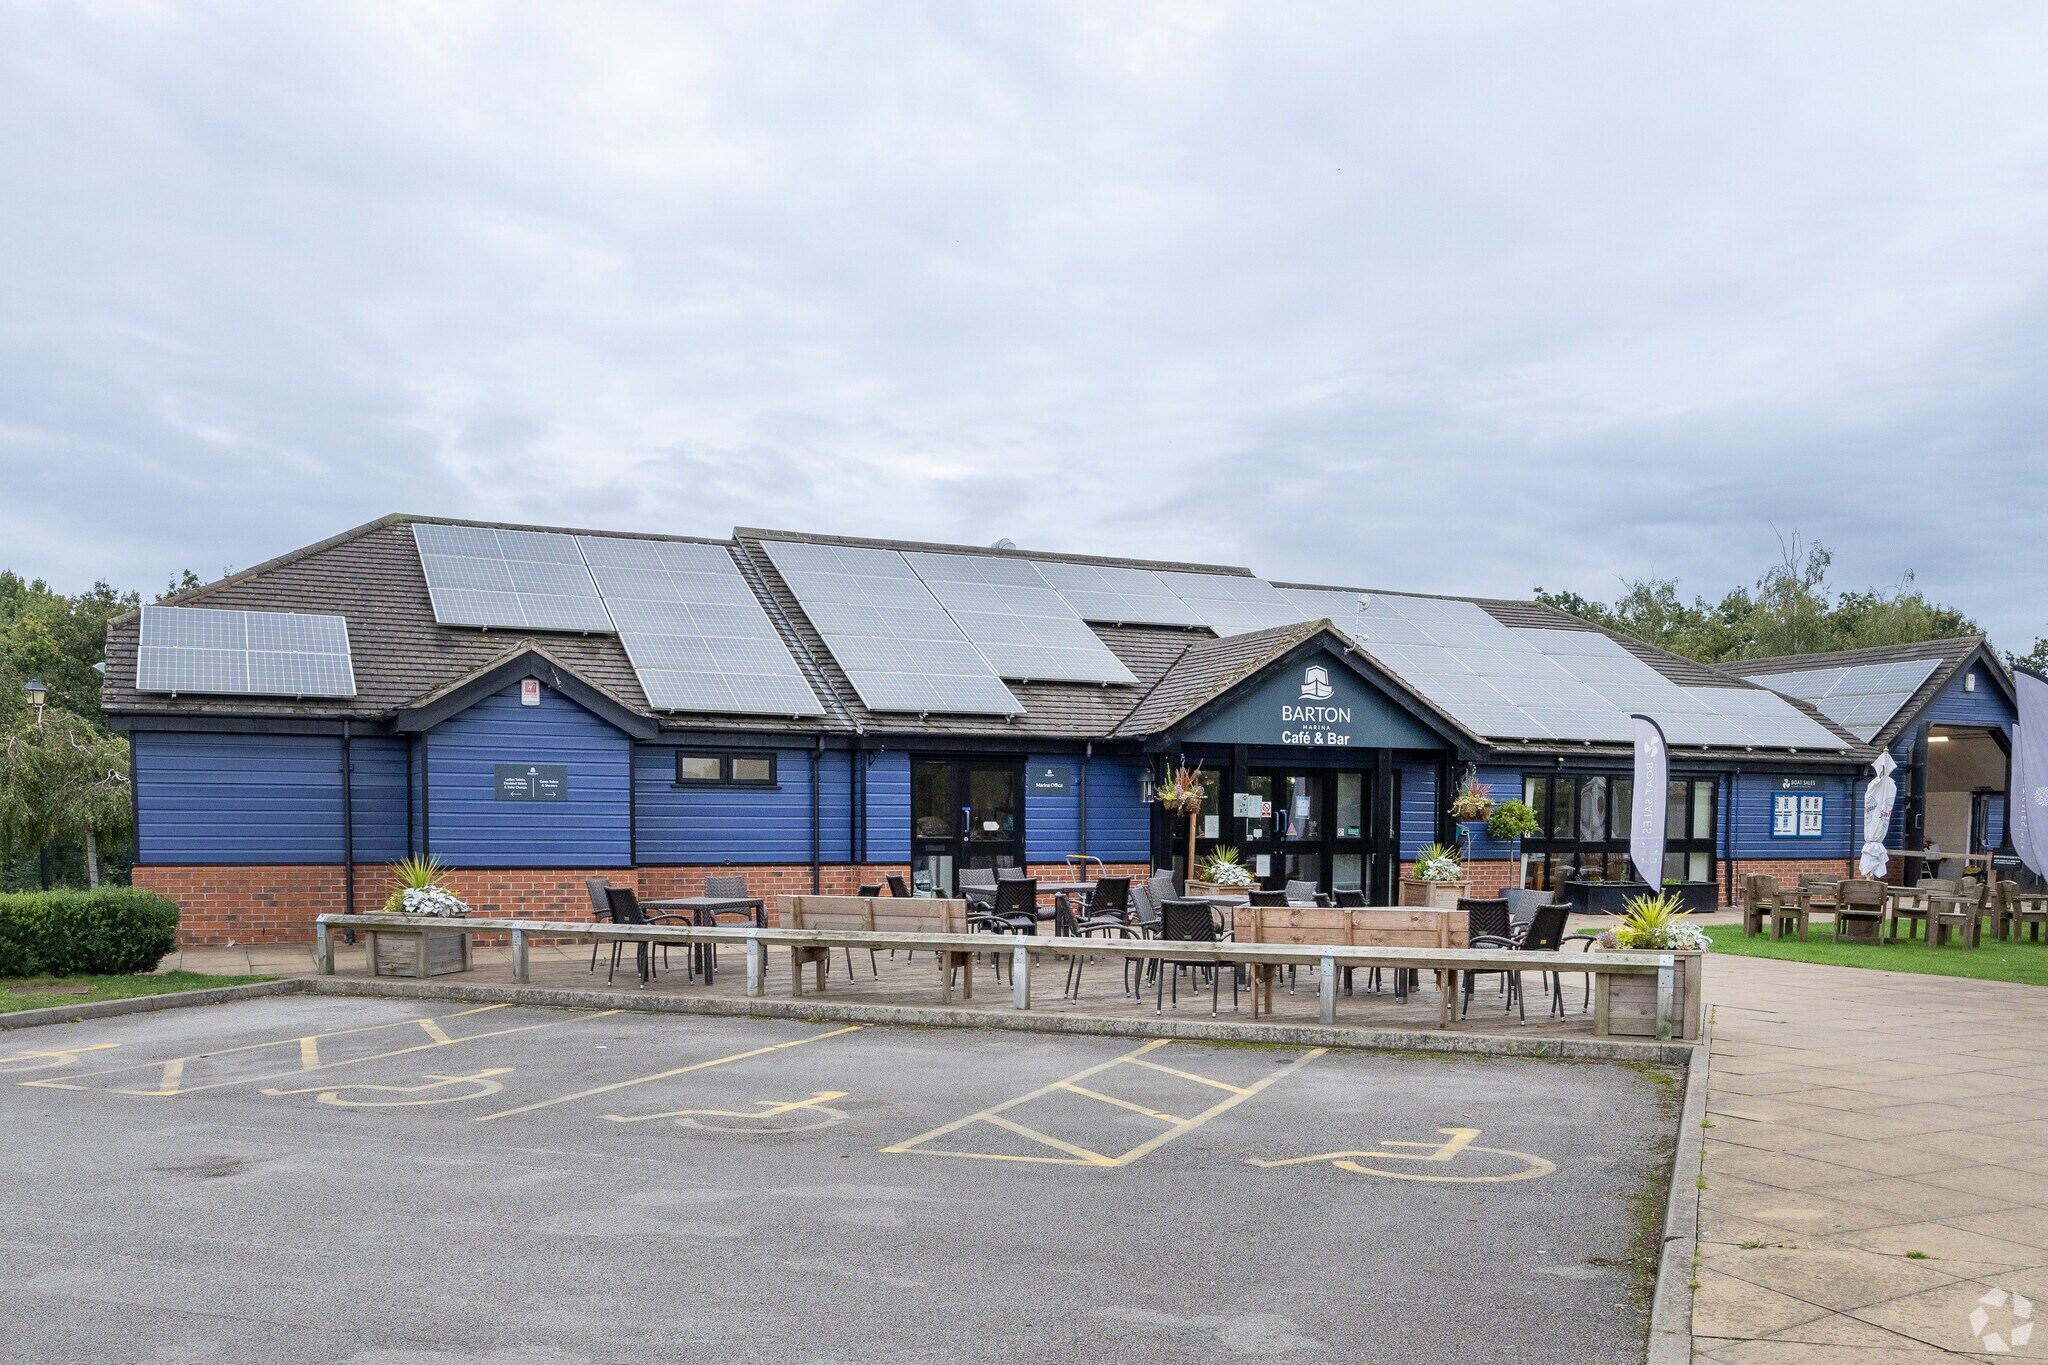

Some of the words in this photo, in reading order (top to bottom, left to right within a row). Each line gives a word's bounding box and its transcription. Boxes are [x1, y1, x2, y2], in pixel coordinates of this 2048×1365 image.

[1282, 705, 1351, 723] BARTON
[1282, 730, 1311, 744] Café
[1314, 731, 1324, 745] &
[1327, 732, 1350, 745] Bar
